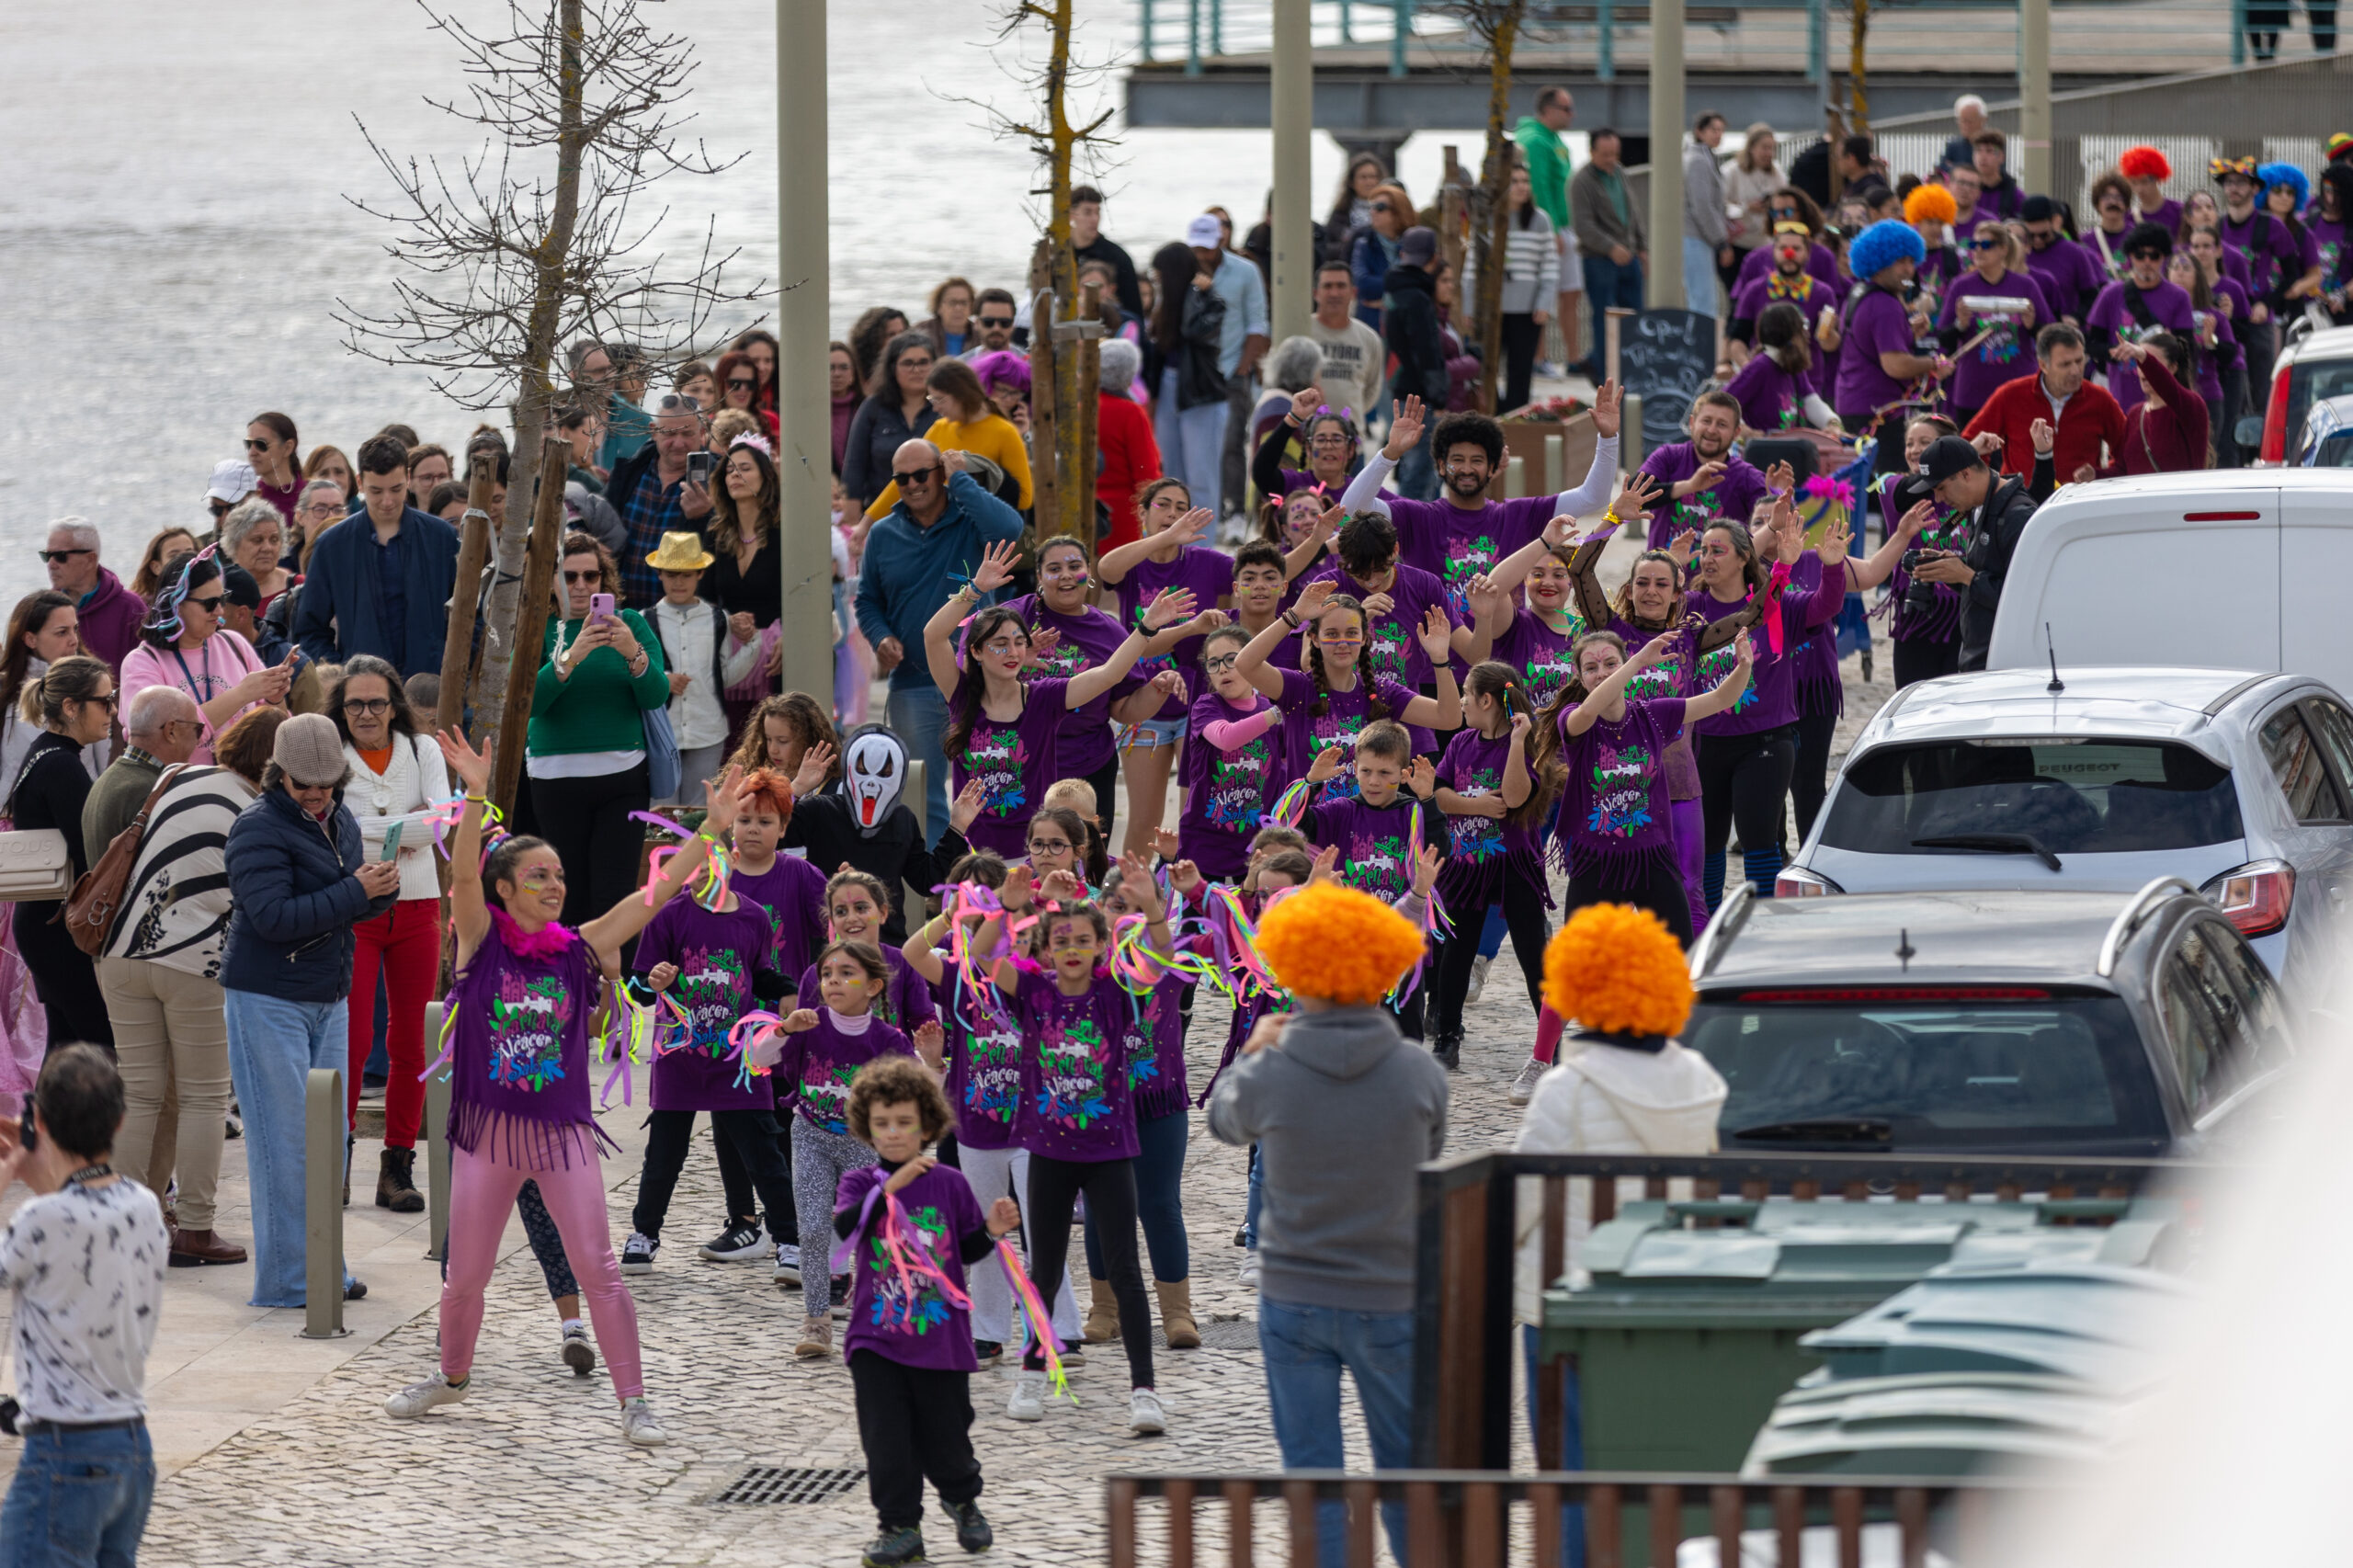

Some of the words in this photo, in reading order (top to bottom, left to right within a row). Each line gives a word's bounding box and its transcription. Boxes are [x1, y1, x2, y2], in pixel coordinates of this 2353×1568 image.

[972, 756, 1023, 779] Carnaval
[1219, 767, 1266, 790] Carnaval
[2038, 762, 2120, 773] PEUGEOT
[1598, 773, 1652, 800] Carnaval
[684, 979, 741, 1009] Carnaval
[498, 1007, 565, 1041] Carnaval
[1044, 1053, 1103, 1079] Carnaval
